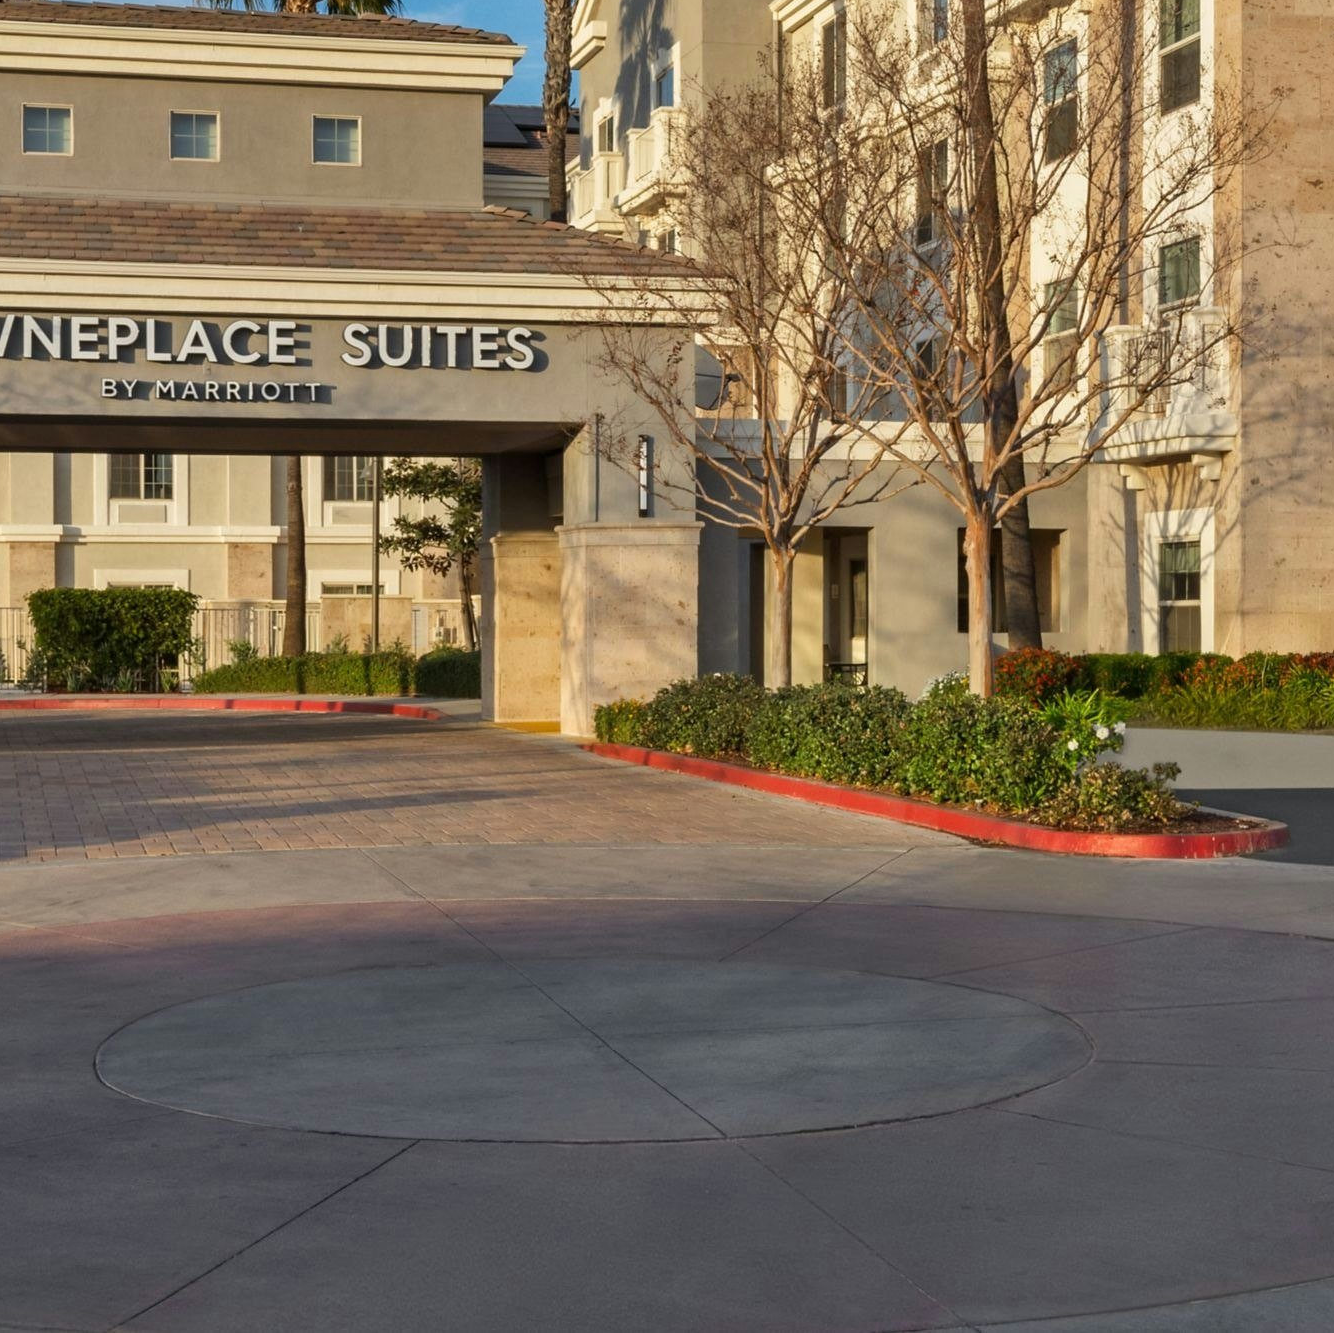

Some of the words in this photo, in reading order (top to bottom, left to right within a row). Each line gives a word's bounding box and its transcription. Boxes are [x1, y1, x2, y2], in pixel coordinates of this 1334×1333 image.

[341, 323, 534, 369] SUITES
[101, 378, 138, 398] BY
[155, 379, 321, 401] MARRIOTT
